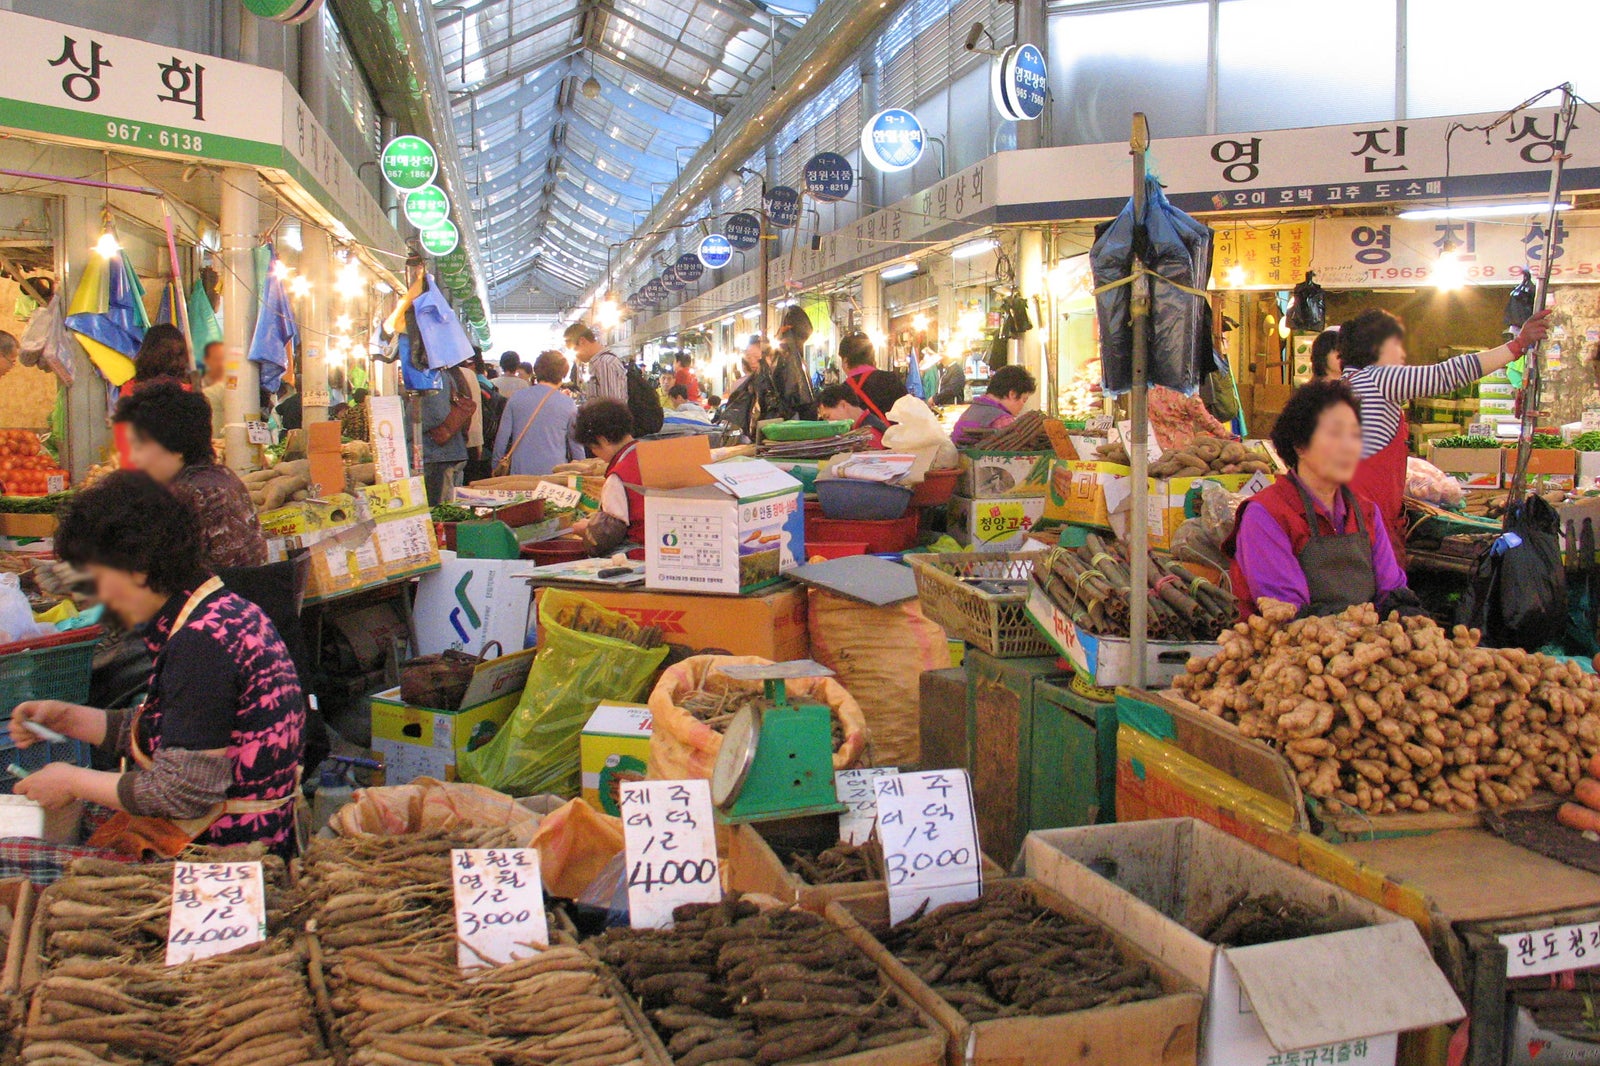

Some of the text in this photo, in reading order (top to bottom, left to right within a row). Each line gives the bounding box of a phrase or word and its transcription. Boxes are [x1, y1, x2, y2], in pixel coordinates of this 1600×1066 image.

[47, 35, 206, 121] 상회
[1015, 66, 1046, 92] 영진상회
[807, 169, 852, 182] 정원식품
[1233, 191, 1265, 206] 오이
[1280, 188, 1312, 204] 호박
[1328, 186, 1360, 200] 고추
[1269, 229, 1282, 280] 위탁판매
[981, 516, 1032, 531] 청양고추
[622, 785, 691, 806] 제주
[878, 775, 953, 798] 제주
[627, 810, 697, 830] 더덕
[881, 803, 955, 825] 더덕
[176, 864, 255, 884] 강원도
[462, 910, 530, 935] 3.000
